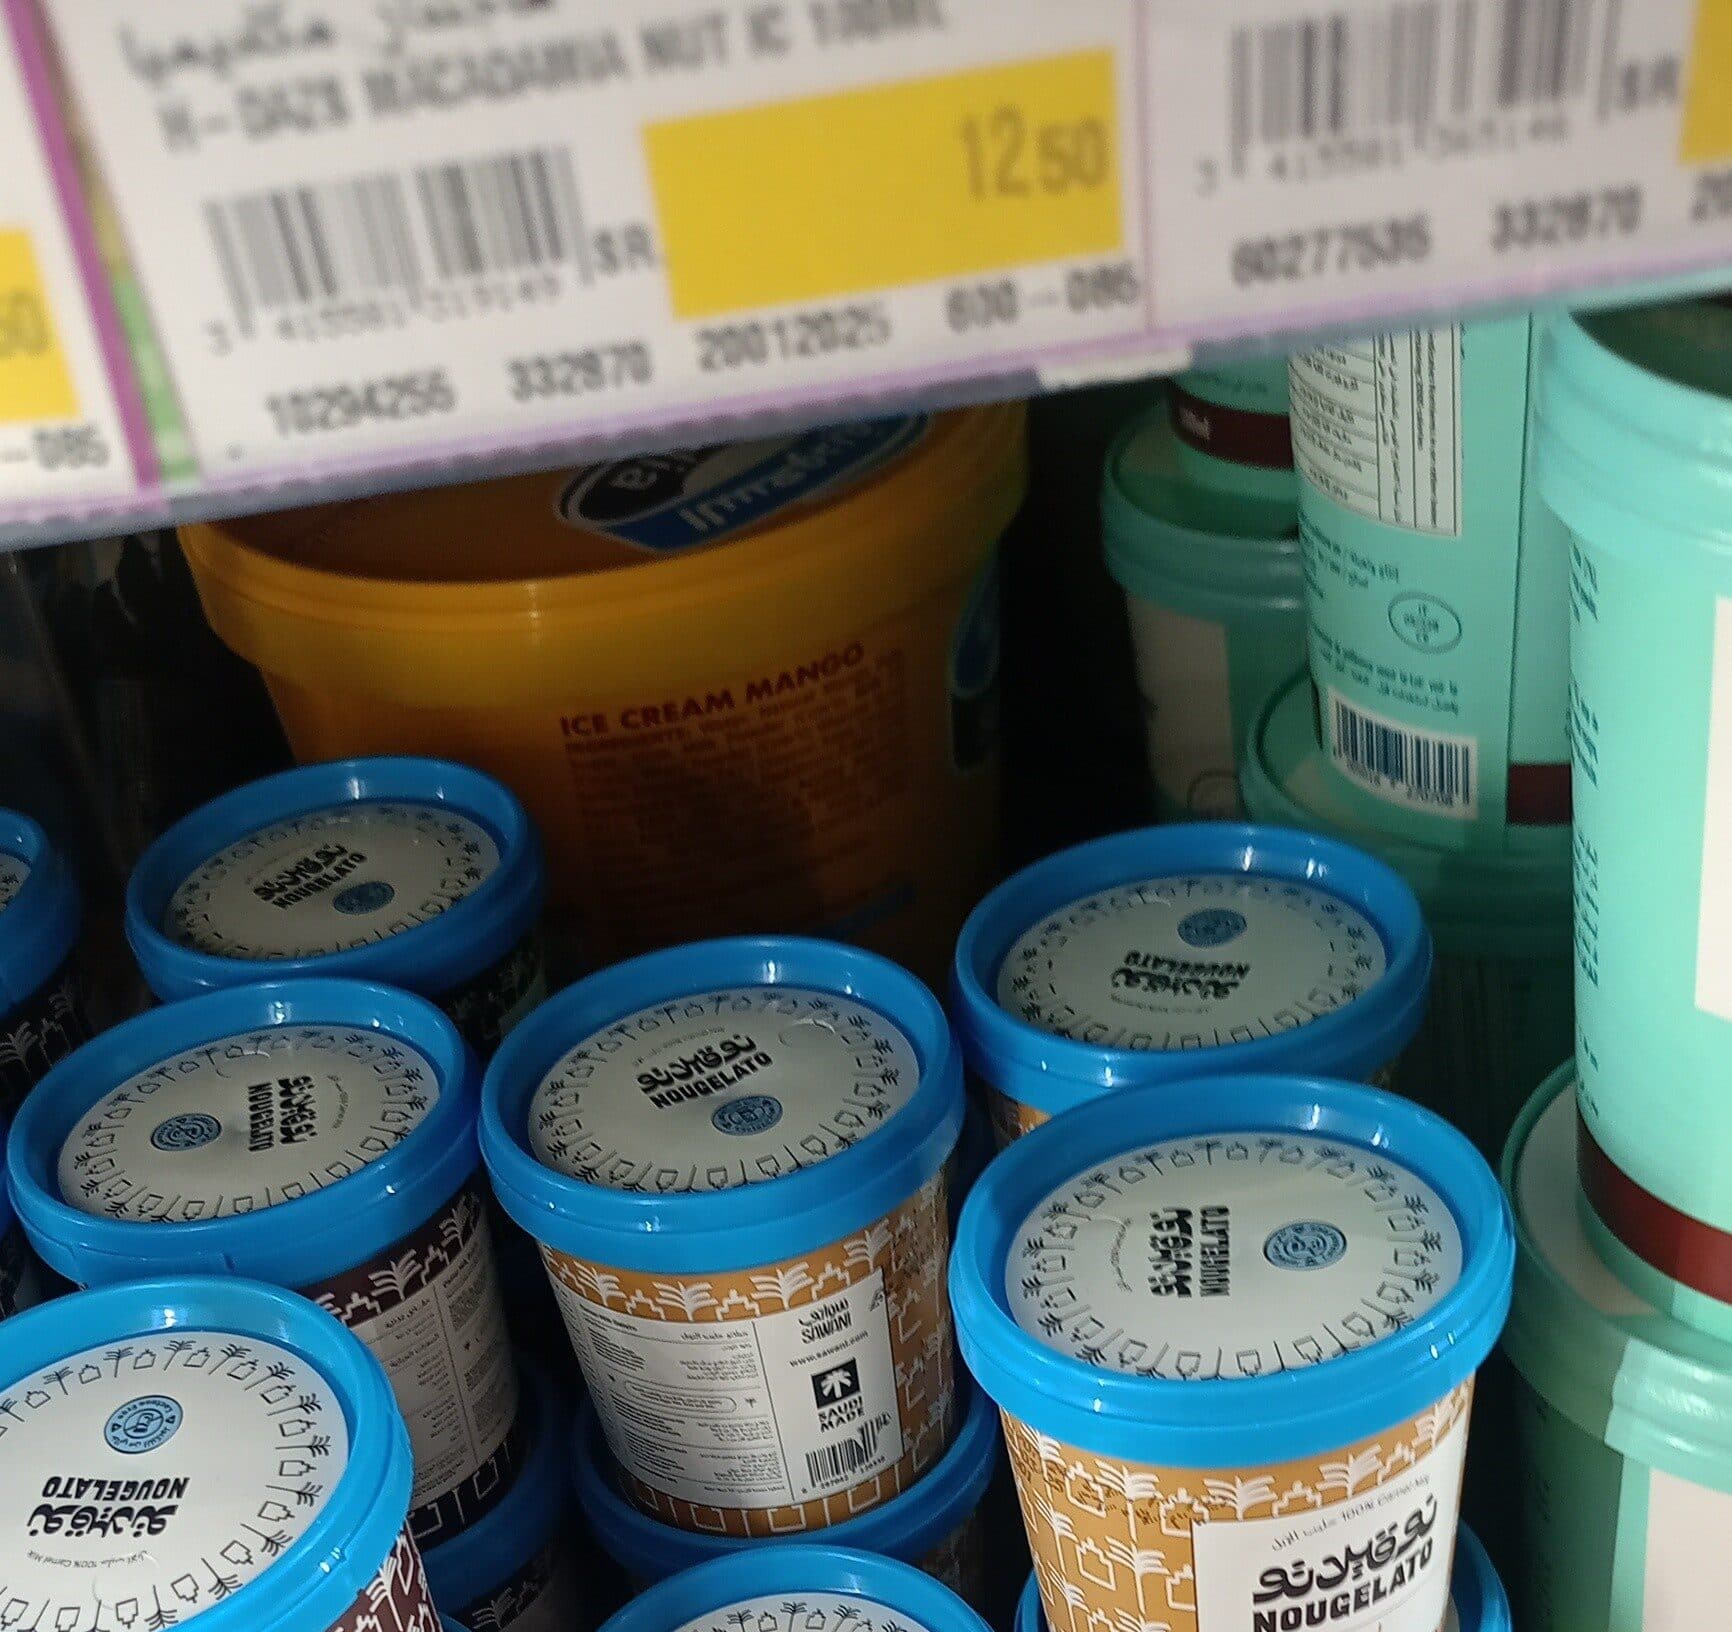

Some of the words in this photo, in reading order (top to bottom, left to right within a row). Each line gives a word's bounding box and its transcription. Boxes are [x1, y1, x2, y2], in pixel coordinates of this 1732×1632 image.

[560, 713, 610, 738] ICE
[620, 690, 736, 731] CREAM
[745, 640, 866, 703] MANGO
[648, 1051, 774, 1109] NOUGELATO
[248, 1082, 275, 1152] NOUGELATO
[801, 1311, 853, 1345] SAWANI
[818, 1396, 864, 1422] SAUDI
[820, 1407, 866, 1433] MADE
[41, 1475, 191, 1502] NOUGELATO
